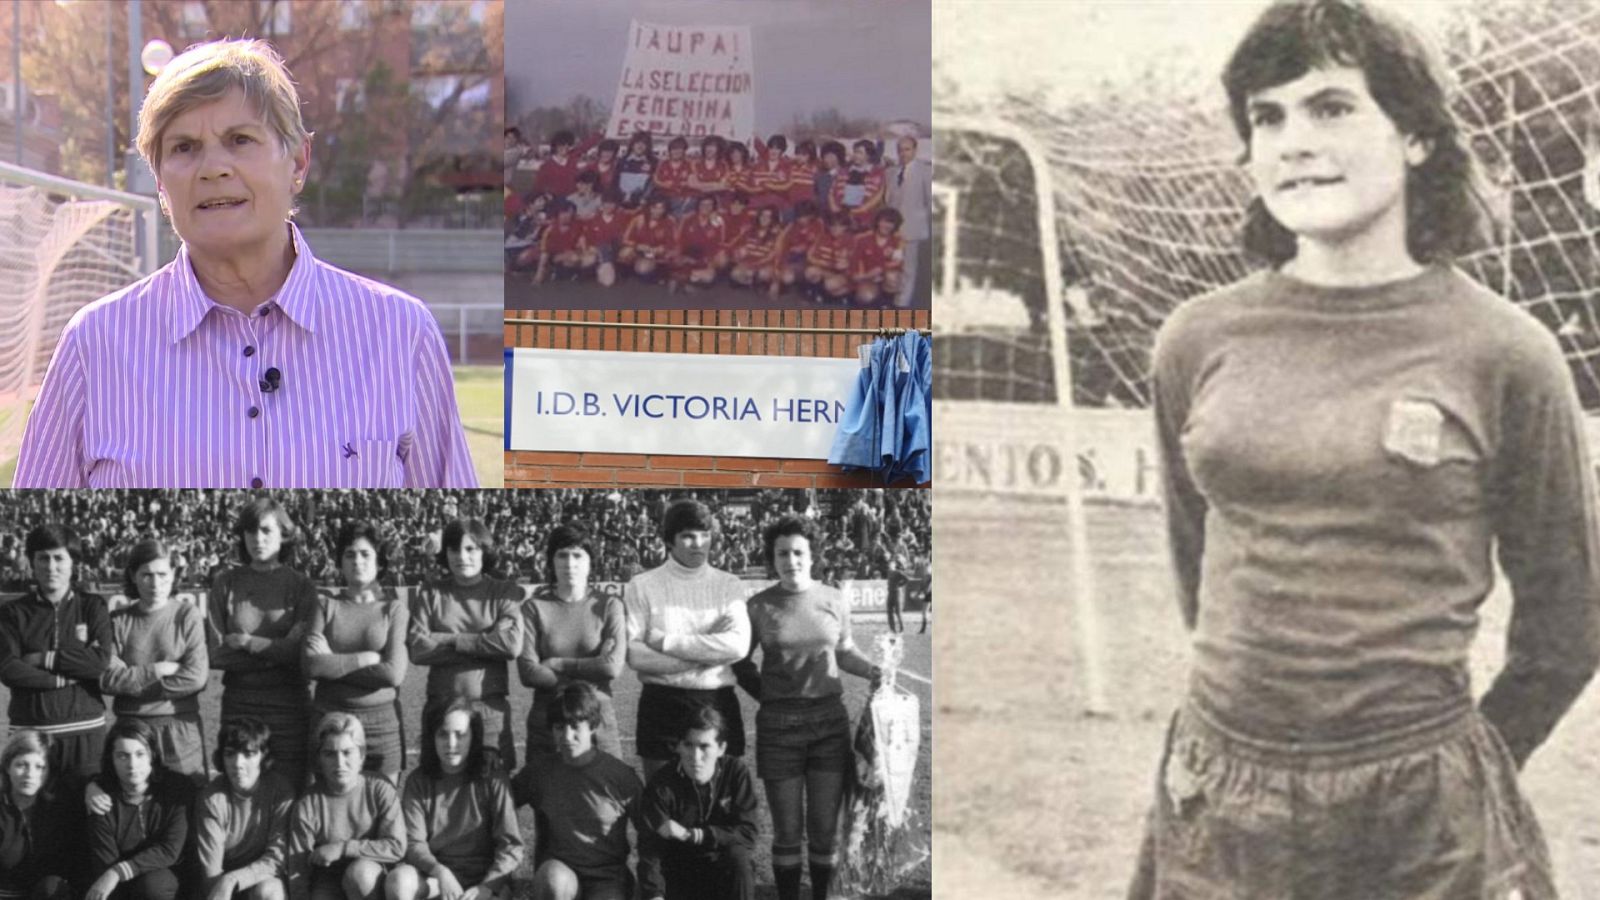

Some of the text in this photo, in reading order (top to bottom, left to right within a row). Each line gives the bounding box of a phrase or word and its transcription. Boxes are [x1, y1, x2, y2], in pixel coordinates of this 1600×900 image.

[622, 67, 644, 89] LA
[620, 93, 732, 120] FEMENINA
[536, 390, 607, 417] I.D.B.
[612, 392, 761, 422] VICTORIA
